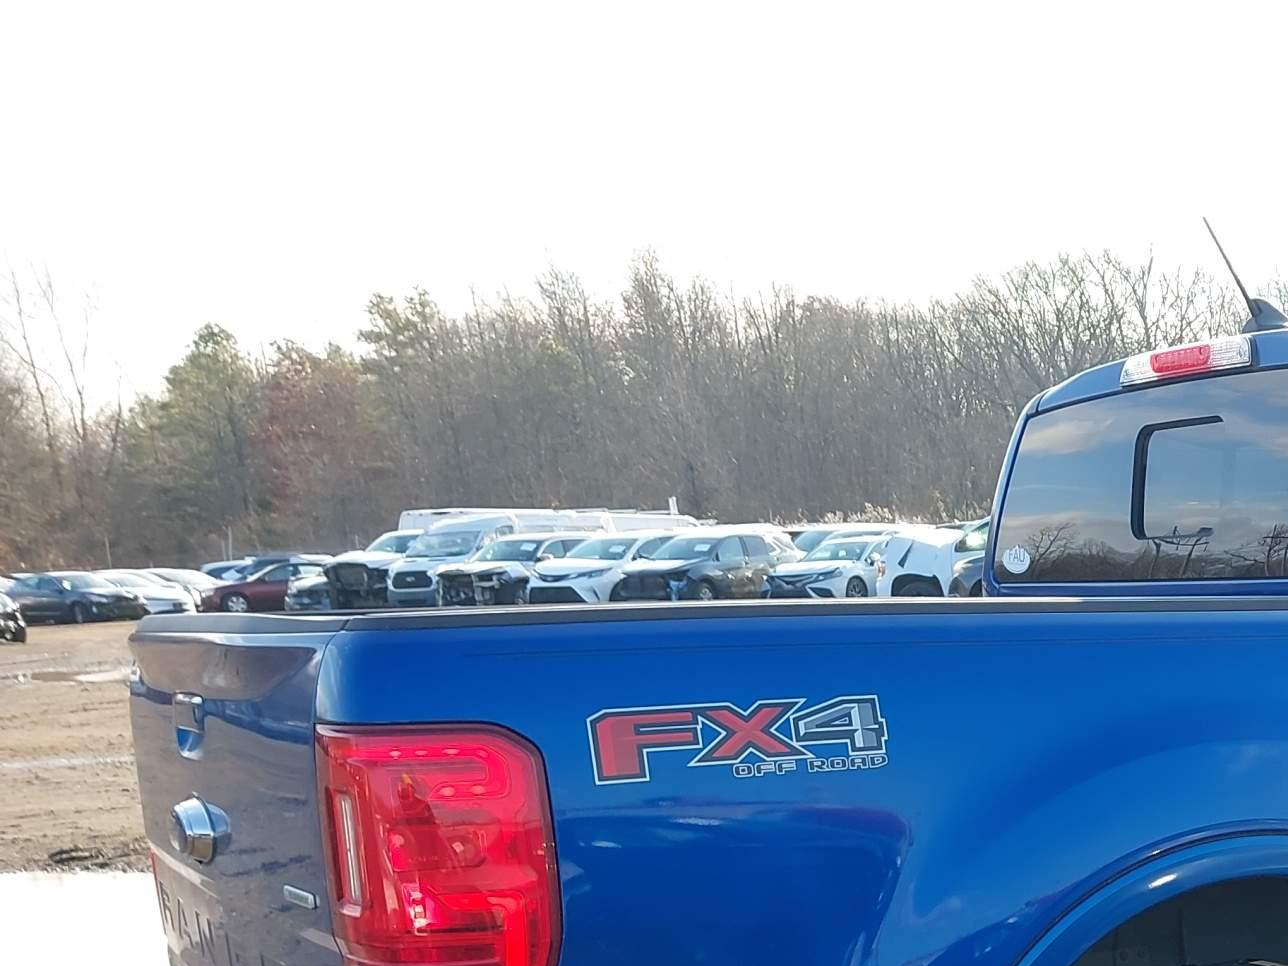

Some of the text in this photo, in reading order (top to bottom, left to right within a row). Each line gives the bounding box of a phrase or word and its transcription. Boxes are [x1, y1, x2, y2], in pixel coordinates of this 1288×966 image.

[586, 695, 888, 785] FX4
[732, 752, 889, 778] OFF ROAD
